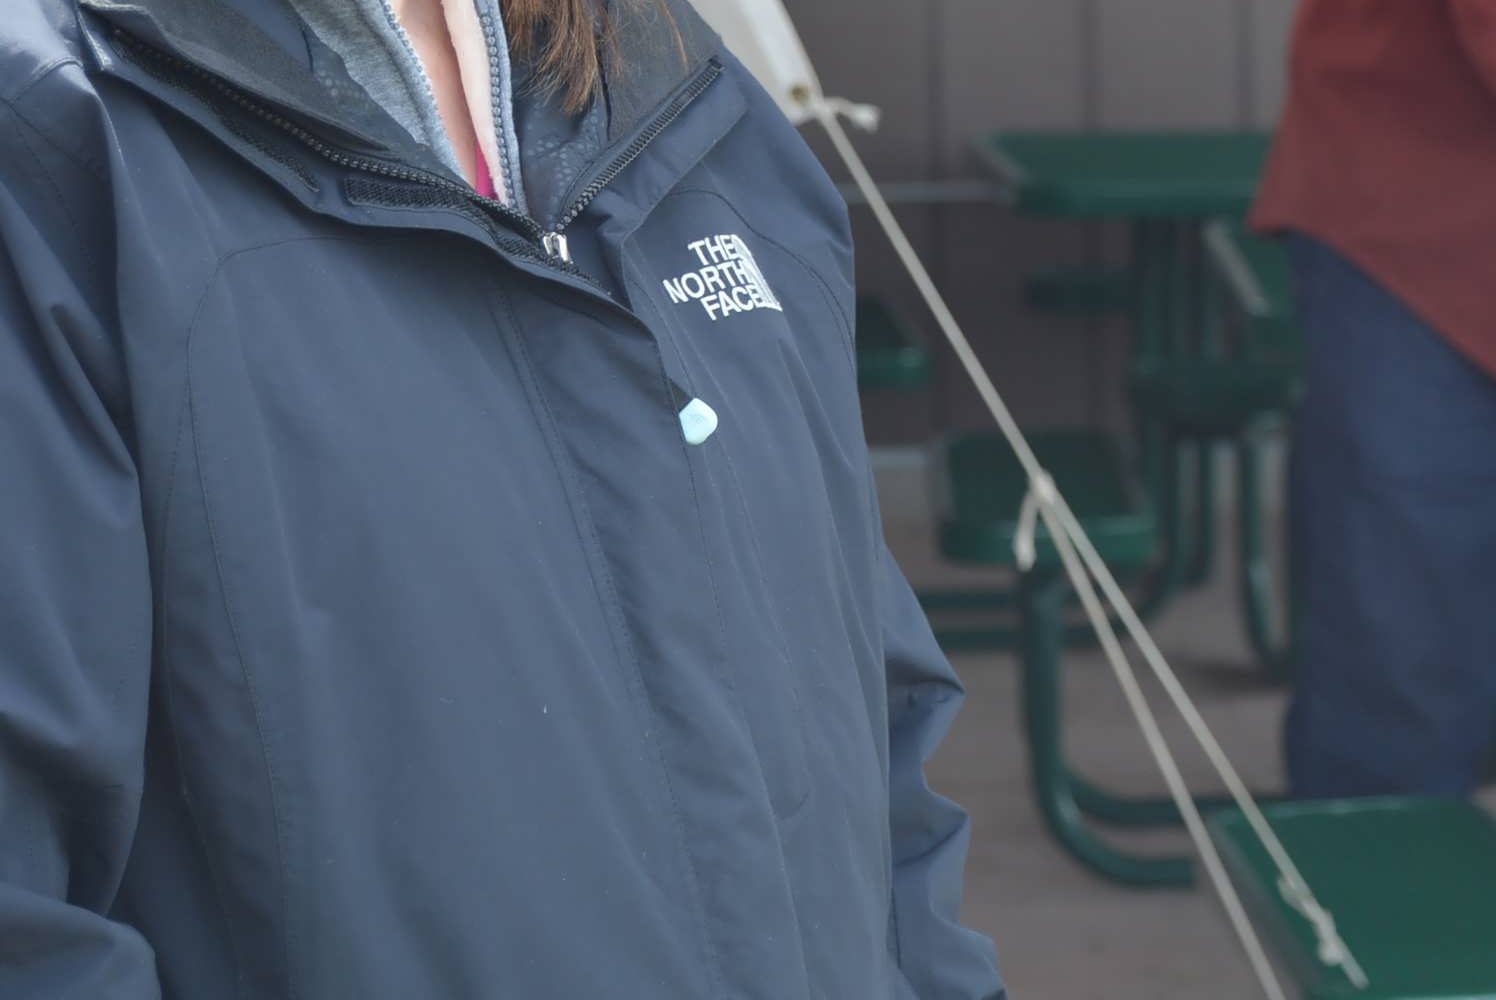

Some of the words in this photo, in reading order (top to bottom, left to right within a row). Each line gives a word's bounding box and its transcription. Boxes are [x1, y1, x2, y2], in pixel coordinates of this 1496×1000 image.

[687, 234, 743, 266] THE
[662, 259, 753, 304] NORTH
[700, 285, 764, 321] FACE
